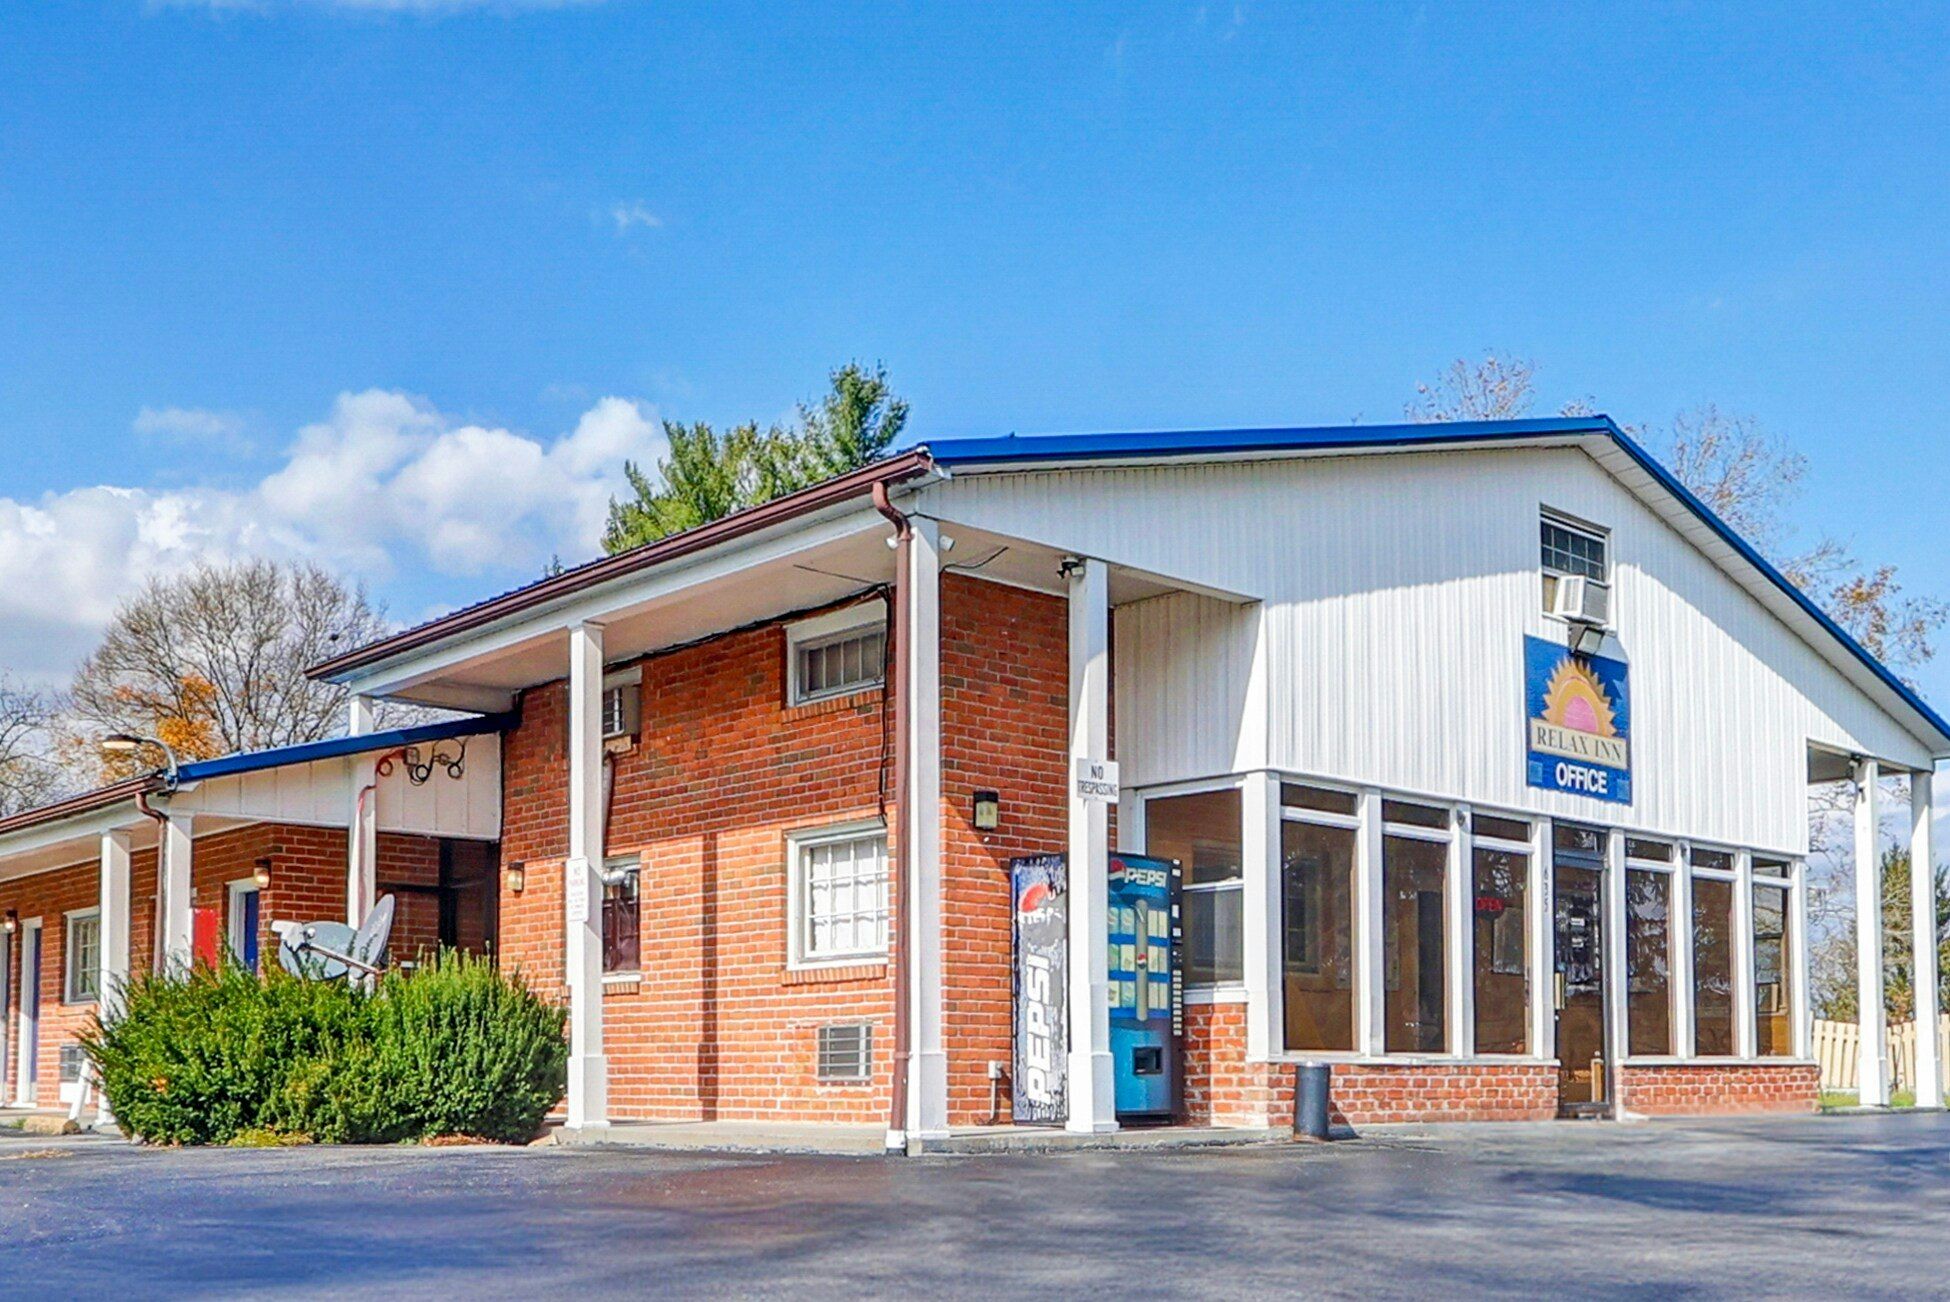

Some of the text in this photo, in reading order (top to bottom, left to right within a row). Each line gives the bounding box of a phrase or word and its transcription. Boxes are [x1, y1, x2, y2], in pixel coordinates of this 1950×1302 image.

[1537, 726, 1622, 760] RELAX INN
[1091, 765, 1104, 780] NO
[1556, 762, 1608, 794] OFFICE
[1078, 780, 1117, 797] TRESPASSING
[1124, 867, 1168, 888] PEPSI
[1027, 954, 1050, 1105] PEPSI
